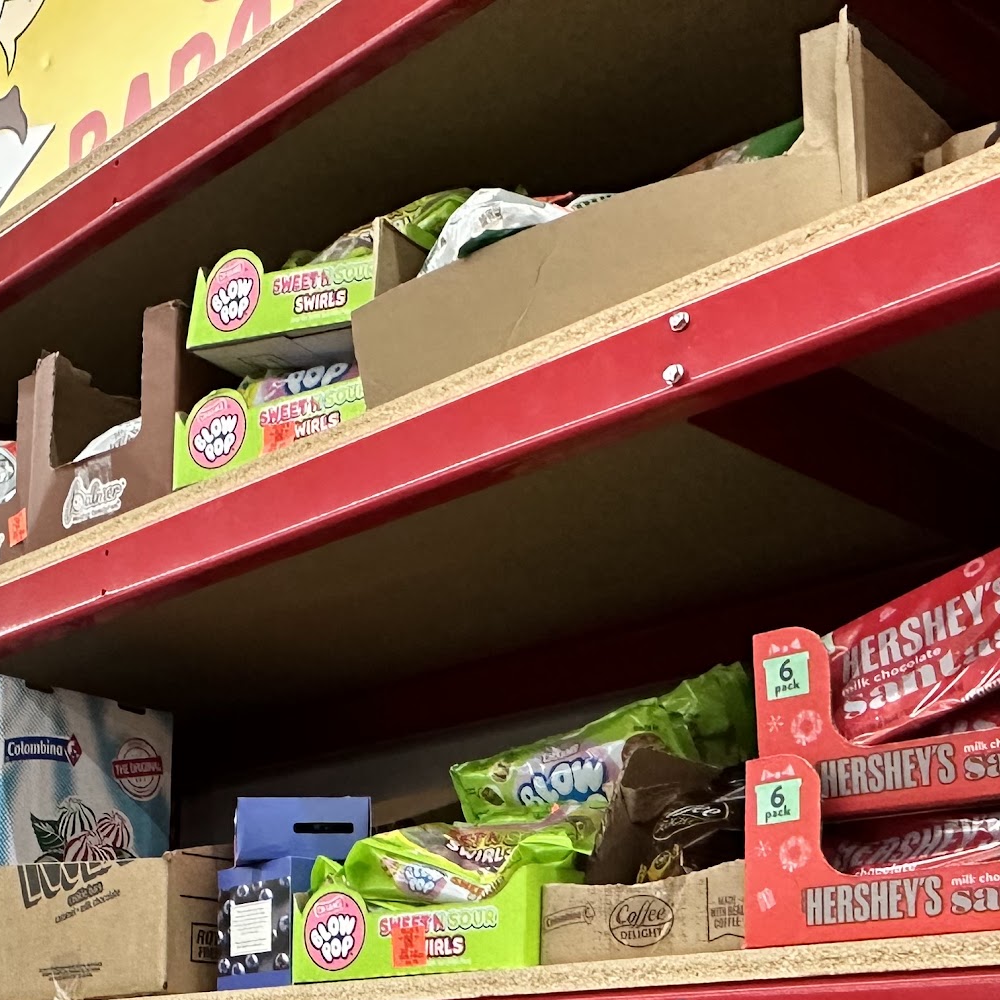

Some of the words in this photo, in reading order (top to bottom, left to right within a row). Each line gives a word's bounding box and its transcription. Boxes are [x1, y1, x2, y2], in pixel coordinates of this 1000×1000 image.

[333, 262, 374, 285] SOU
[211, 277, 254, 314] BLOW
[294, 288, 348, 314] SWIRLS
[220, 295, 251, 326] POP
[285, 362, 350, 395] POP
[324, 383, 365, 410] SOU
[193, 413, 239, 454] BLOW
[294, 410, 341, 441] WIRLS
[203, 432, 237, 463] POP
[779, 658, 793, 683] 6
[873, 647, 942, 683] chocolate
[774, 678, 801, 696] pack
[7, 739, 64, 757] Colombina
[517, 757, 607, 807] BLOW
[818, 742, 958, 800] HERSHEY'S
[963, 741, 988, 753] milk
[770, 785, 786, 809] 6
[765, 806, 792, 824] pack
[616, 900, 667, 928] Coffee
[804, 875, 944, 927] HERSHEY'S
[950, 874, 976, 887] milk
[310, 913, 357, 950] BLOW
[620, 928, 663, 941] DELIGHT
[321, 935, 355, 964] POP
[427, 935, 466, 959] IRLS
